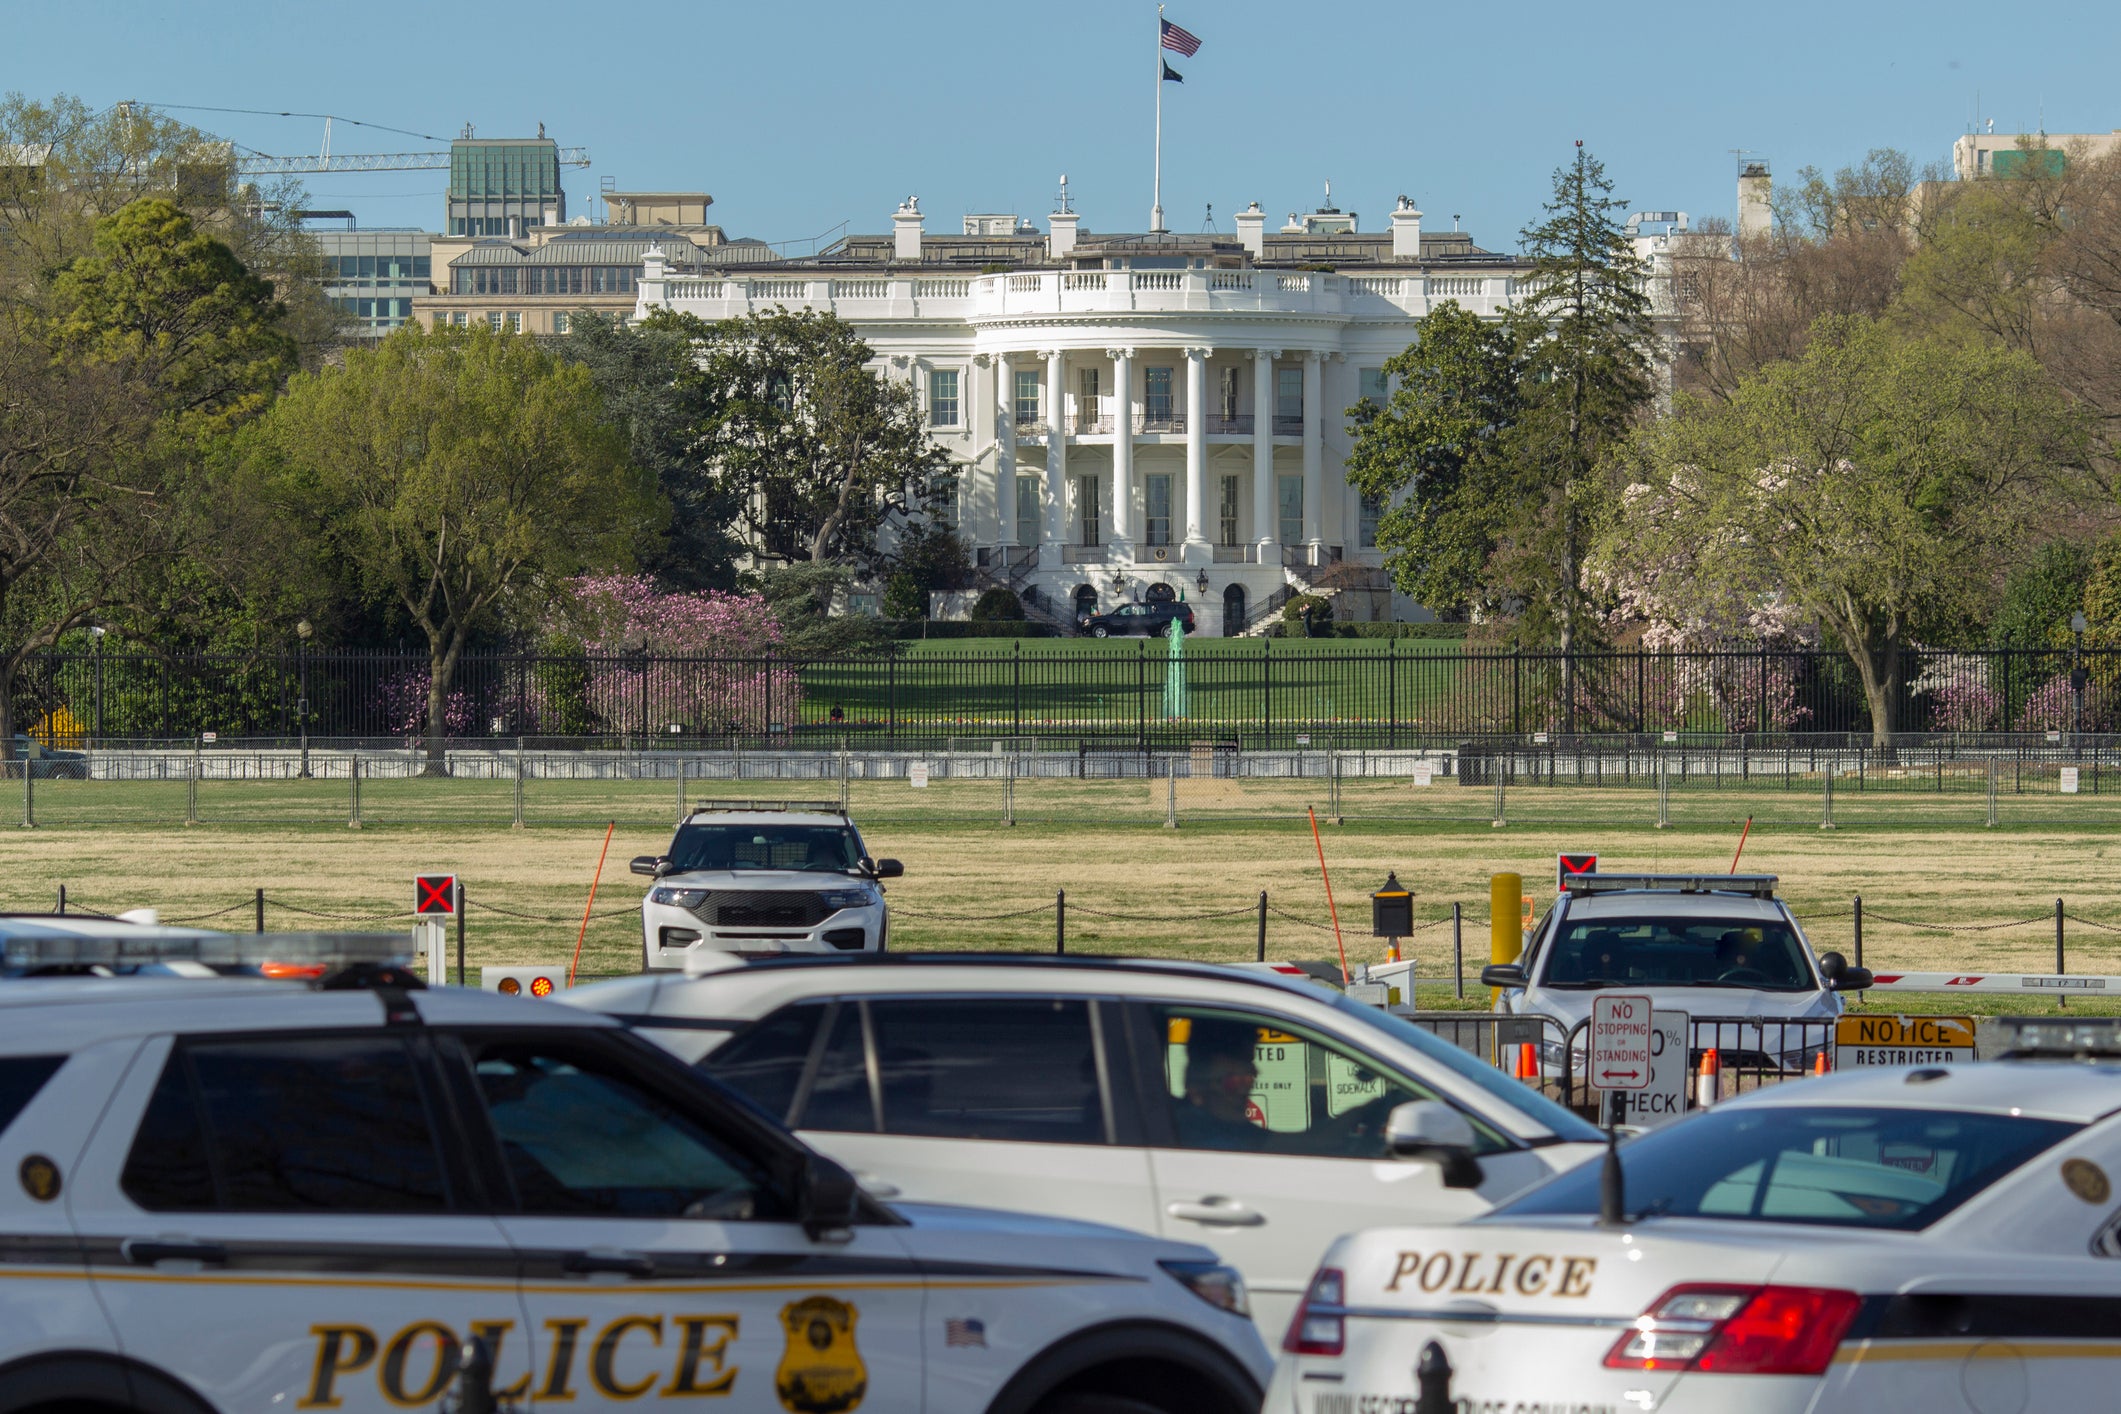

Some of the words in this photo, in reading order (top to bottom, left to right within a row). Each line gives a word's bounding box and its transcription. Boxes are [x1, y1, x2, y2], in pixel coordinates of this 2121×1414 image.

[1611, 1004, 1633, 1019] NO
[1596, 1023, 1647, 1036] STOPPING
[1860, 1020, 1951, 1043] NOTICE
[1596, 1050, 1647, 1062] STANDING
[1273, 1082, 1292, 1090] ONLY
[1336, 1081, 1377, 1095] SIDEWALK
[1625, 1092, 1678, 1114] HECK
[1384, 1250, 1599, 1298] POLICE
[298, 1313, 740, 1408] POLICE
